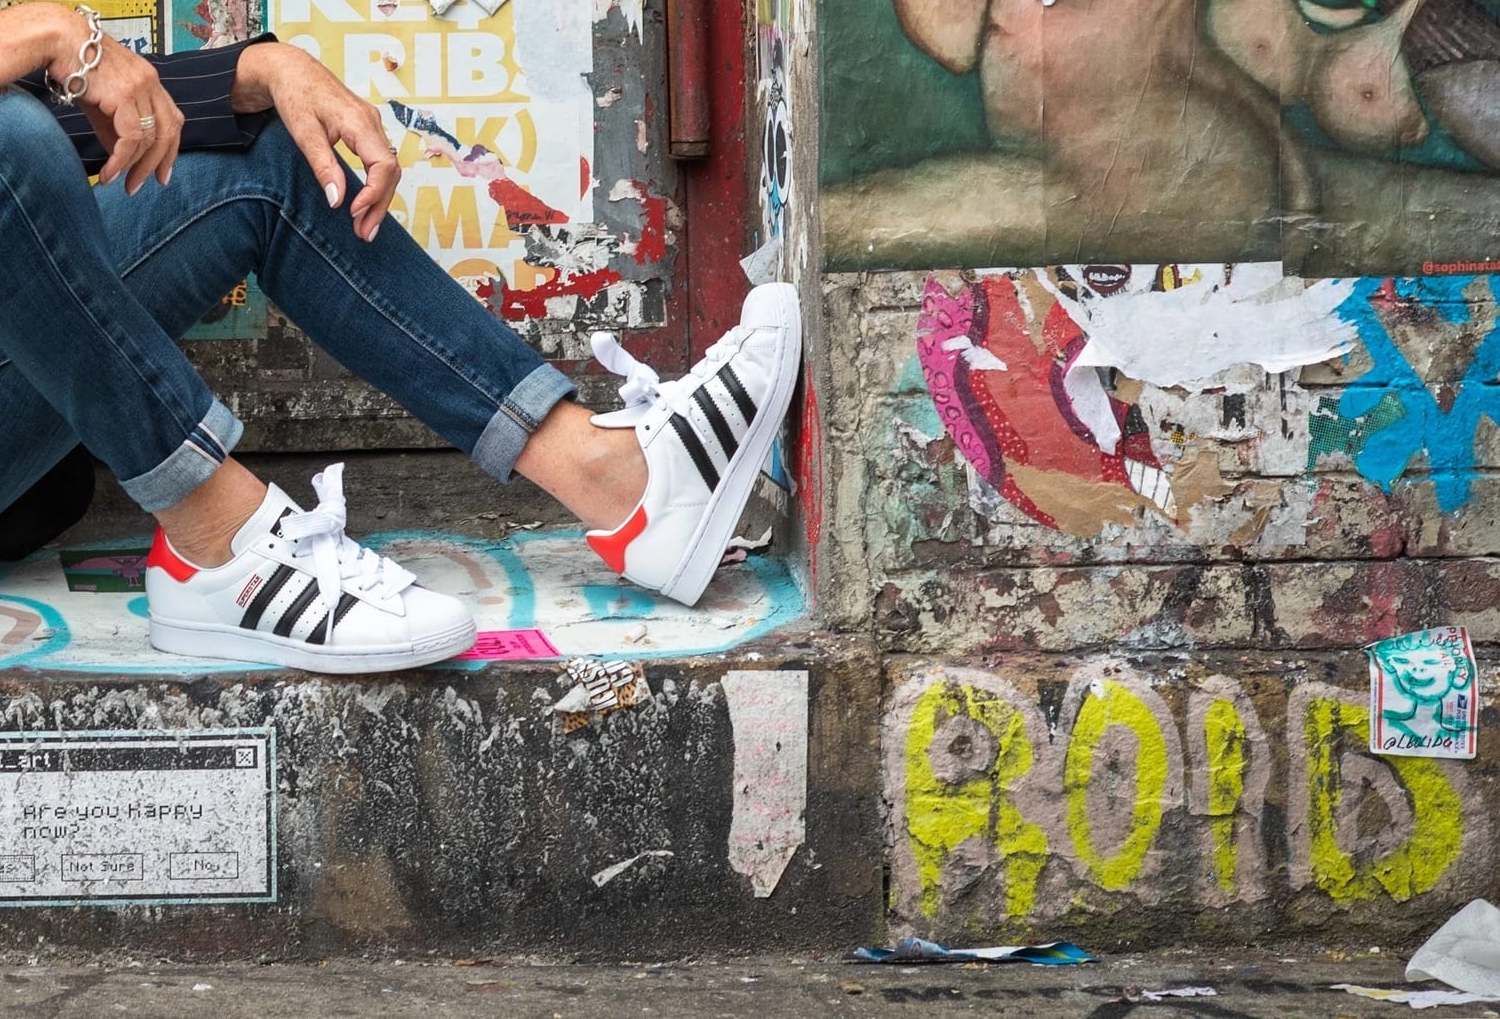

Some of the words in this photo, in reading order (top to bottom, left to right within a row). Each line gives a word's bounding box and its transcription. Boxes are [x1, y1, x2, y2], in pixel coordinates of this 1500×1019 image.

[1446, 626, 1467, 680] PRIORITY
[23, 804, 68, 820] Are
[76, 804, 120, 822] you
[128, 802, 204, 820] happy
[23, 821, 80, 839] now?
[69, 860, 96, 873] Not
[101, 859, 135, 874] Sure
